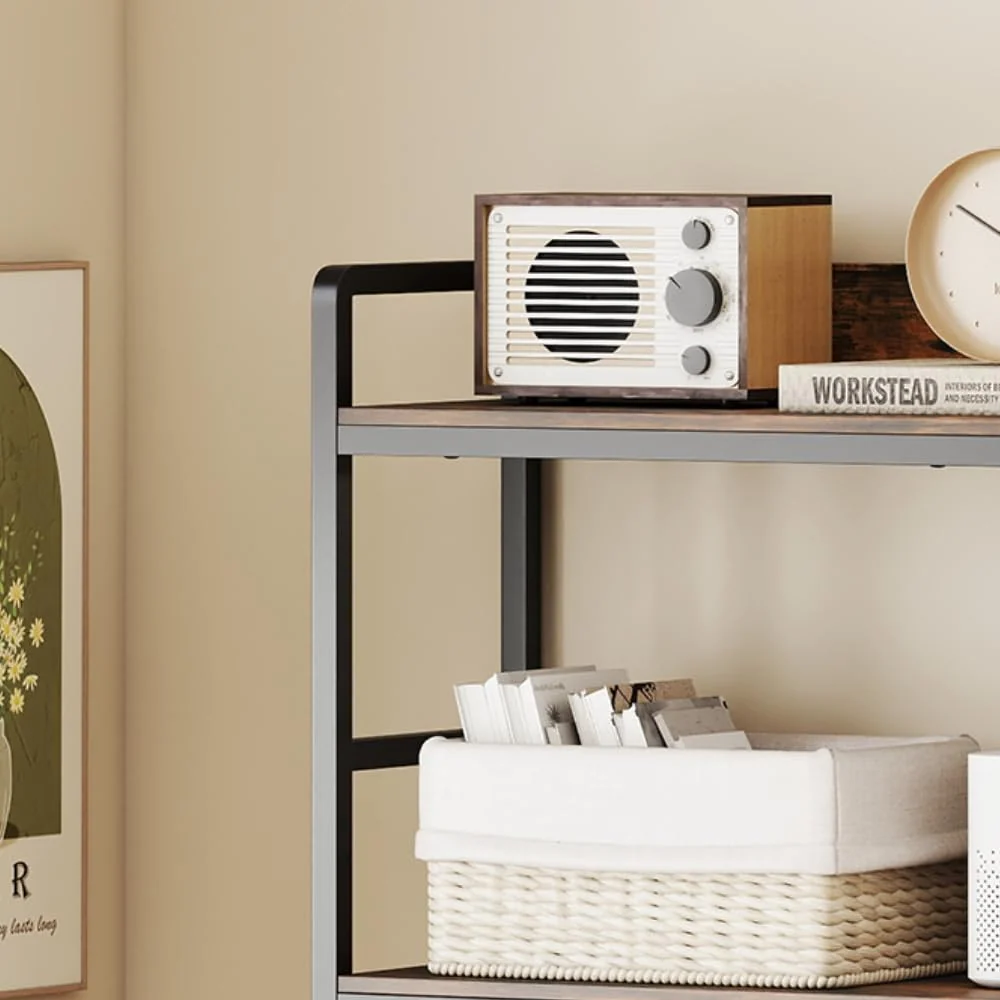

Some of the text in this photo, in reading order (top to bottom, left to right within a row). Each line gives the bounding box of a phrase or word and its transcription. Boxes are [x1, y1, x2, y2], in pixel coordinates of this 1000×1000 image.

[812, 376, 938, 406] WORKSTEAD
[944, 383, 981, 392] INTERIORS
[982, 383, 992, 392] OF
[944, 394, 999, 404] AND NECESSITY
